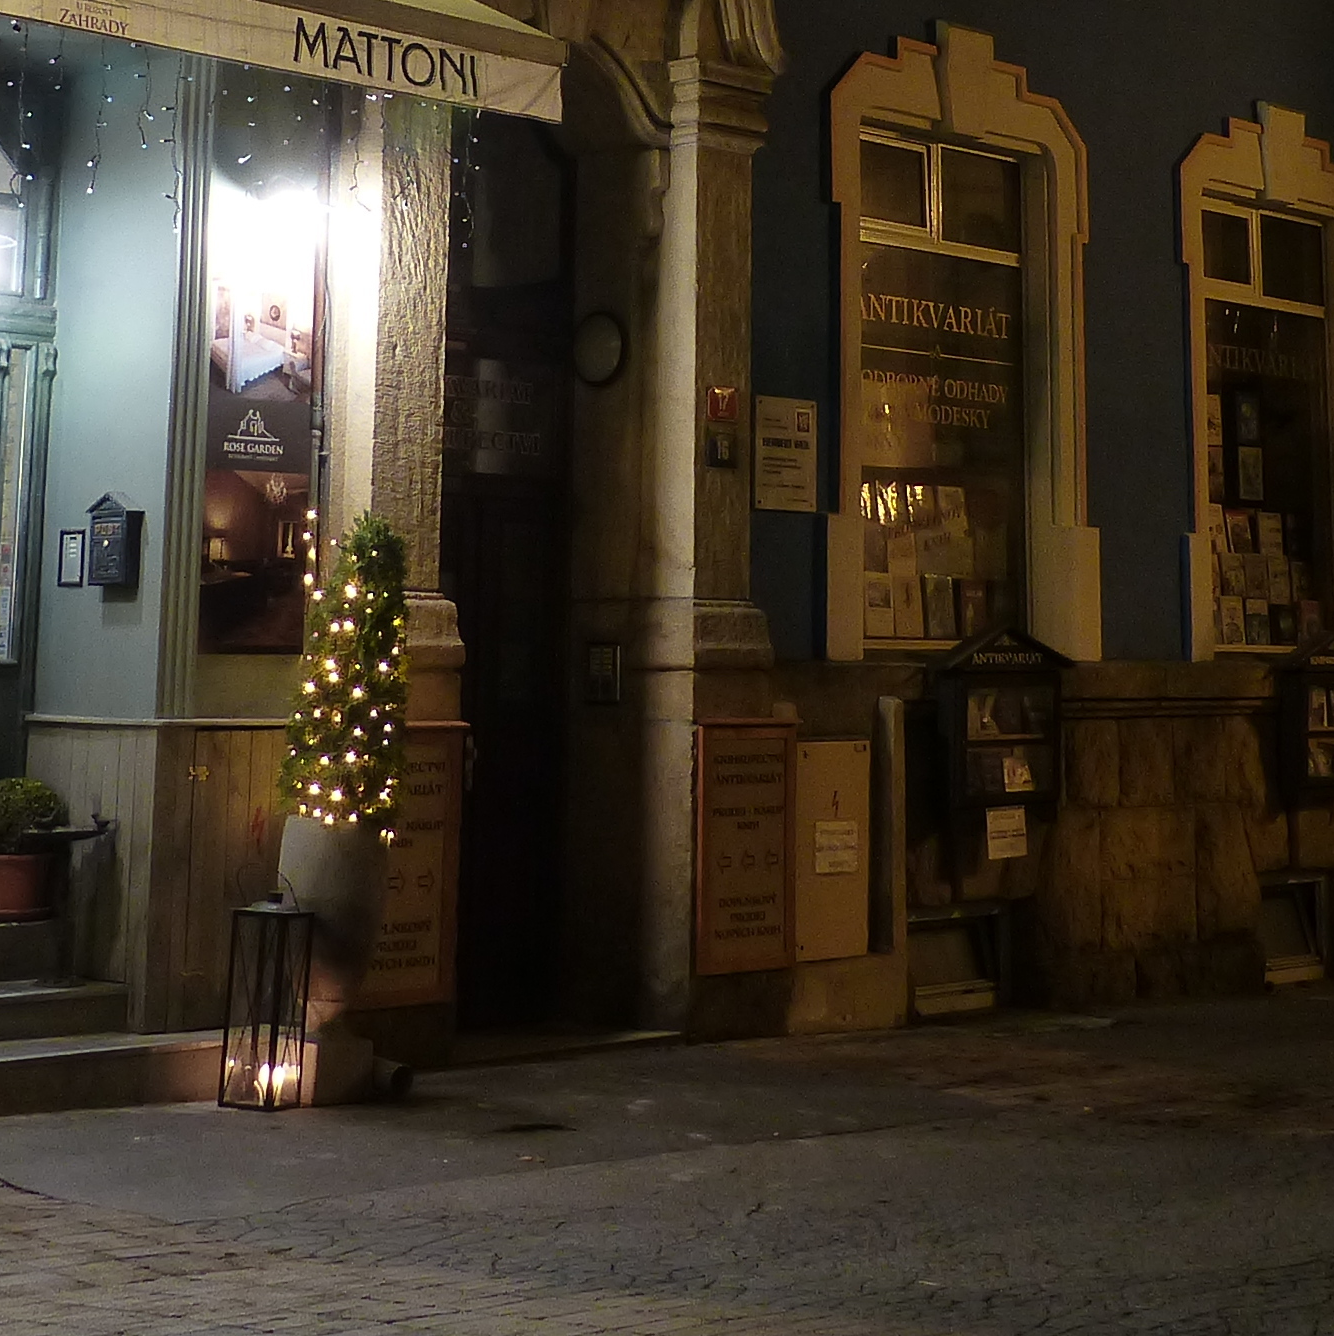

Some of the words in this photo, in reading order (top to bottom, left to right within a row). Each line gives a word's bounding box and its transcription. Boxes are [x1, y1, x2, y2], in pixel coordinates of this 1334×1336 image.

[59, 7, 130, 36] ZAHRADY
[293, 16, 480, 99] MATTONI
[945, 378, 1008, 404] ODHADY
[223, 441, 246, 453] ROSE
[247, 443, 284, 455] GARDEN
